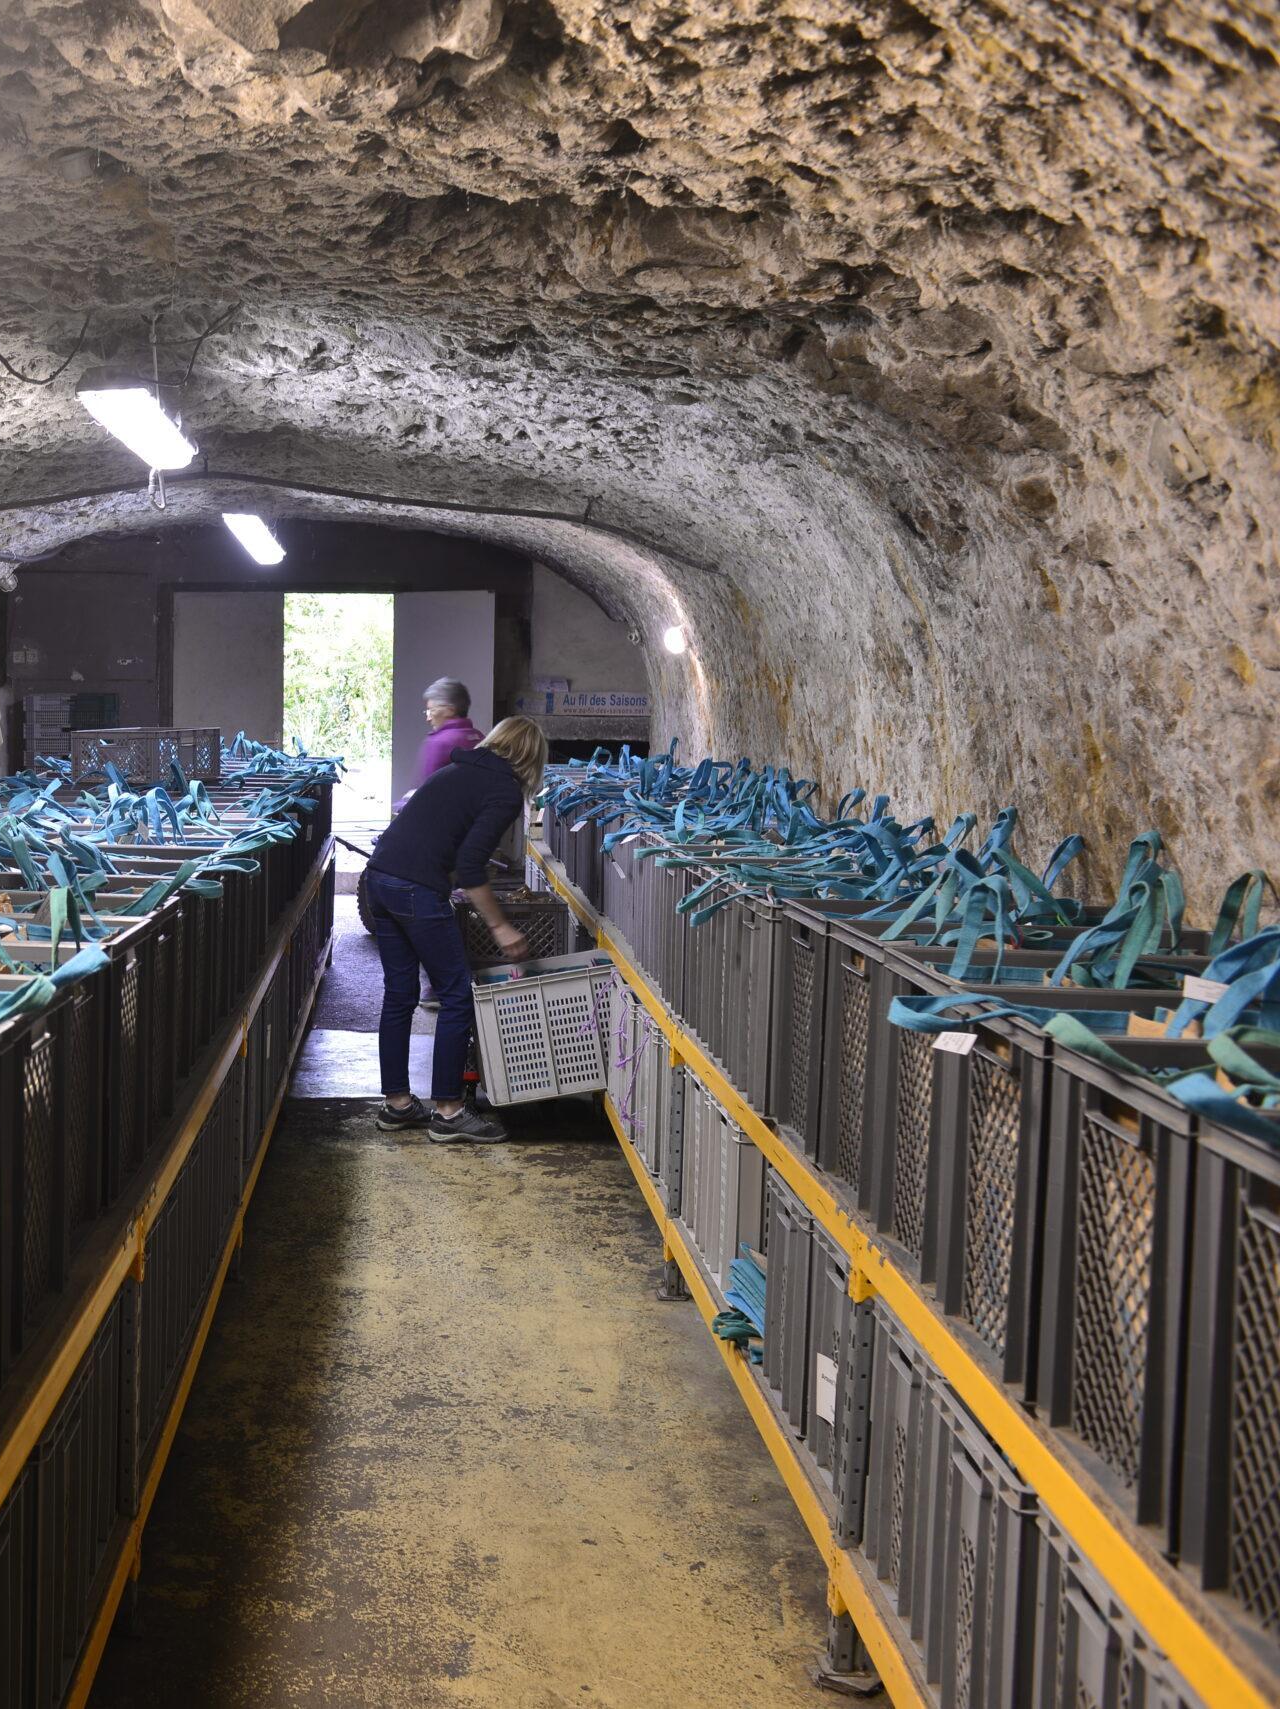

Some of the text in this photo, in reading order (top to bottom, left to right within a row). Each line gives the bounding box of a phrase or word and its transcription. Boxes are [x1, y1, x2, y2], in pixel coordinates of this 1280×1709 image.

[563, 694, 648, 706] Au fil des Saisons
